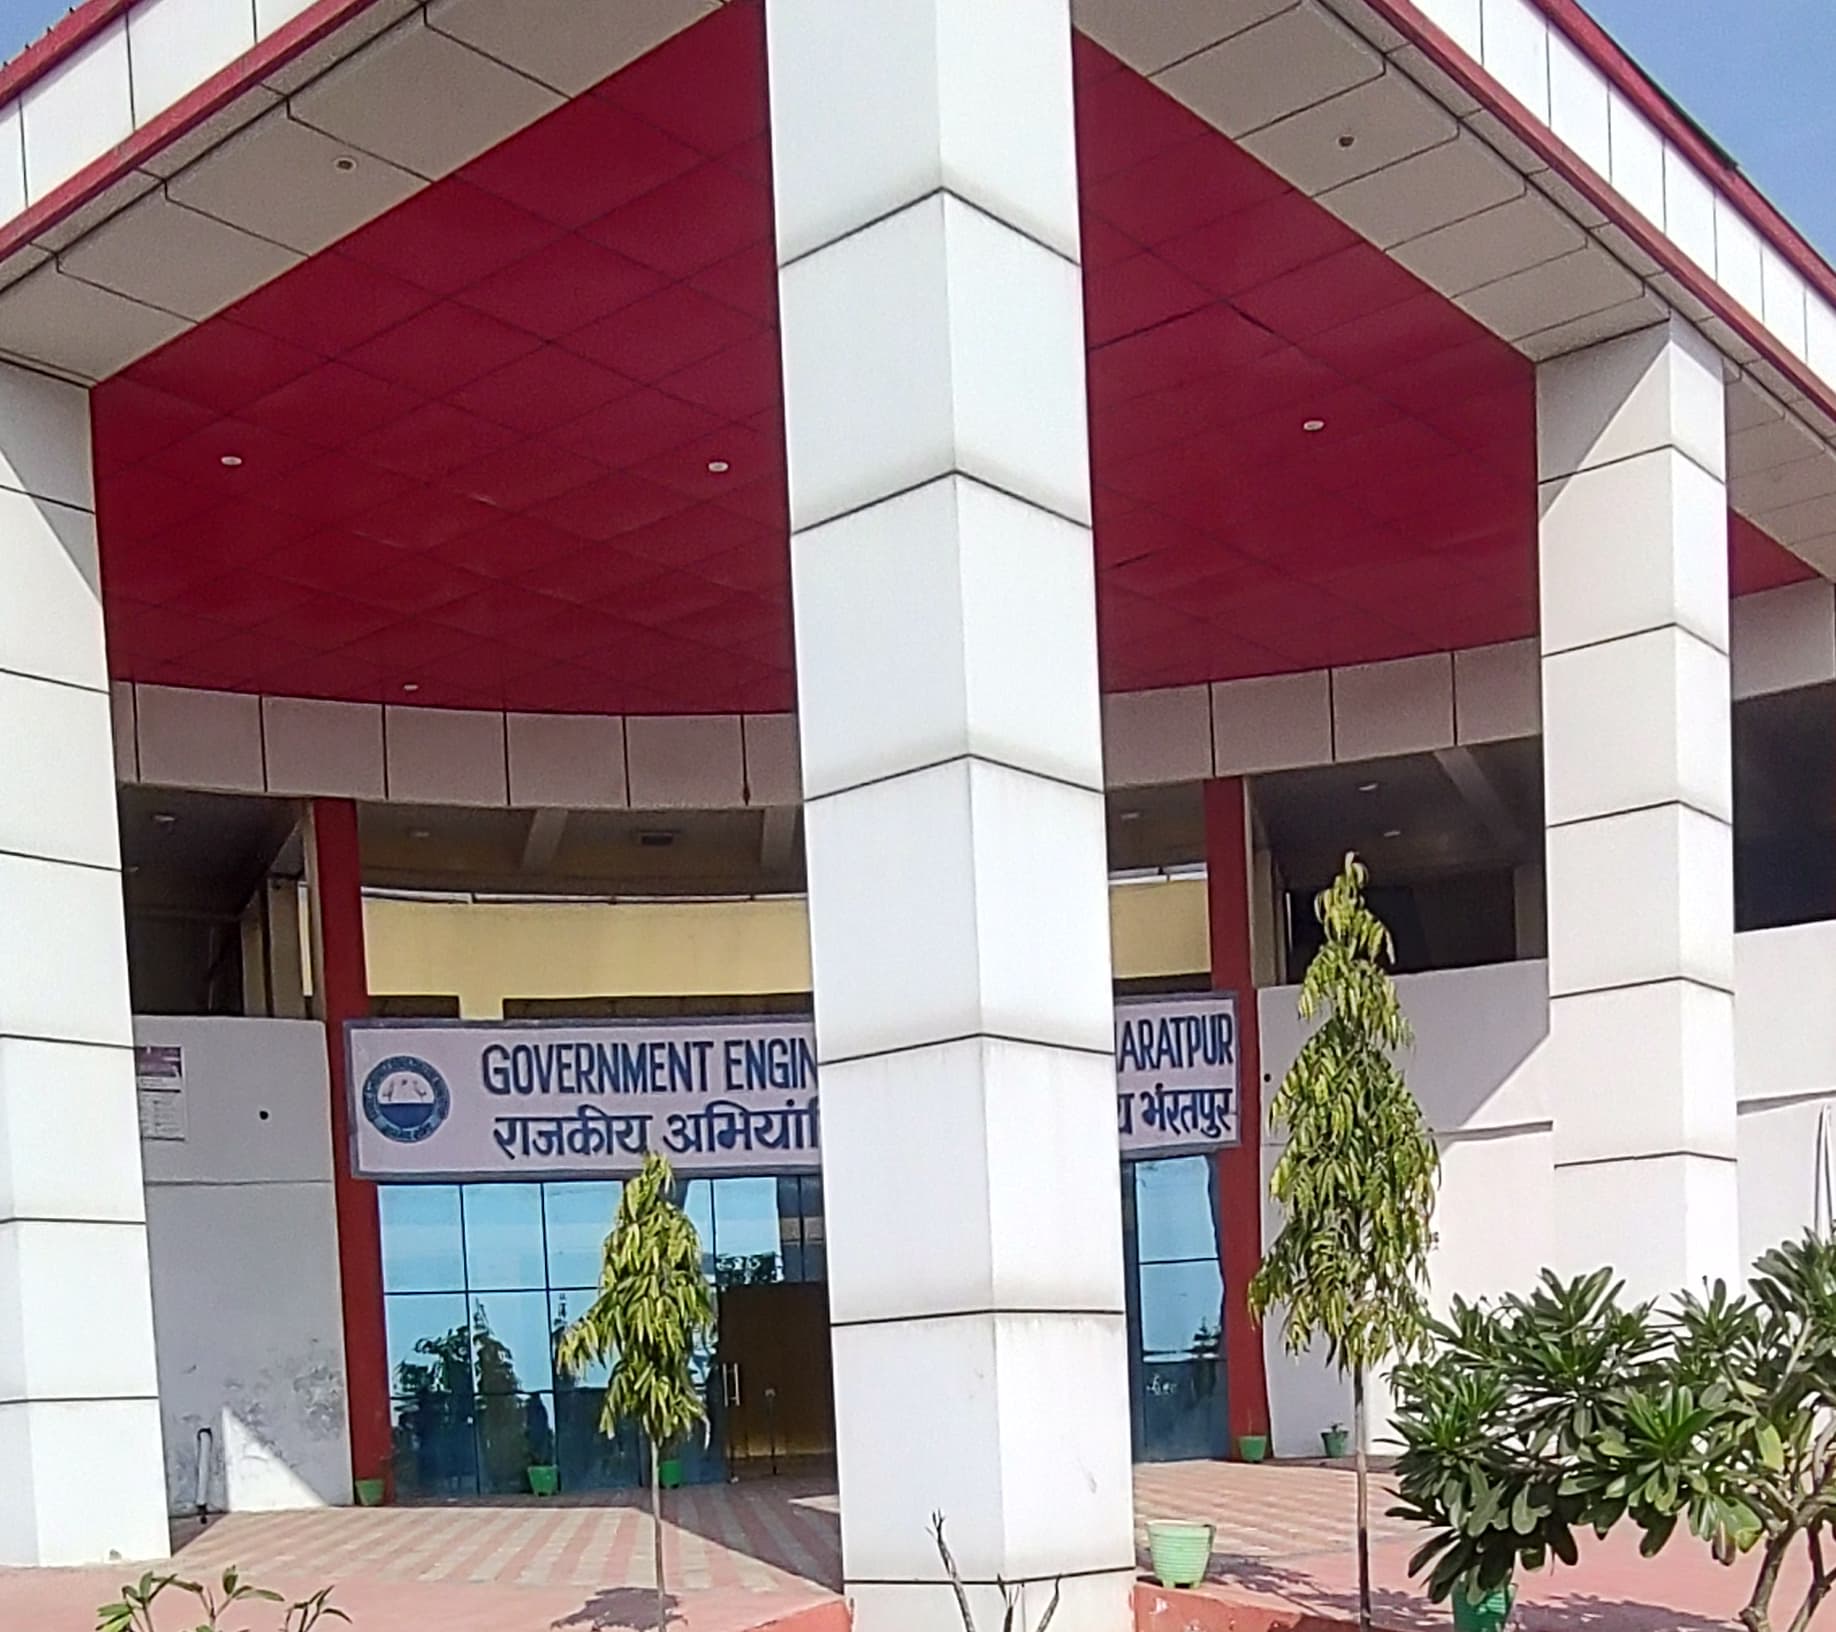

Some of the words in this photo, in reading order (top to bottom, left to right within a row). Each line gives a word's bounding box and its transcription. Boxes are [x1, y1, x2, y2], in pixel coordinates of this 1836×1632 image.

[482, 1041, 714, 1095] GOVERNMENT
[724, 1037, 818, 1091] ENGIN
[1113, 1012, 1233, 1073] ARATPUR
[493, 1104, 653, 1160] राजकीय
